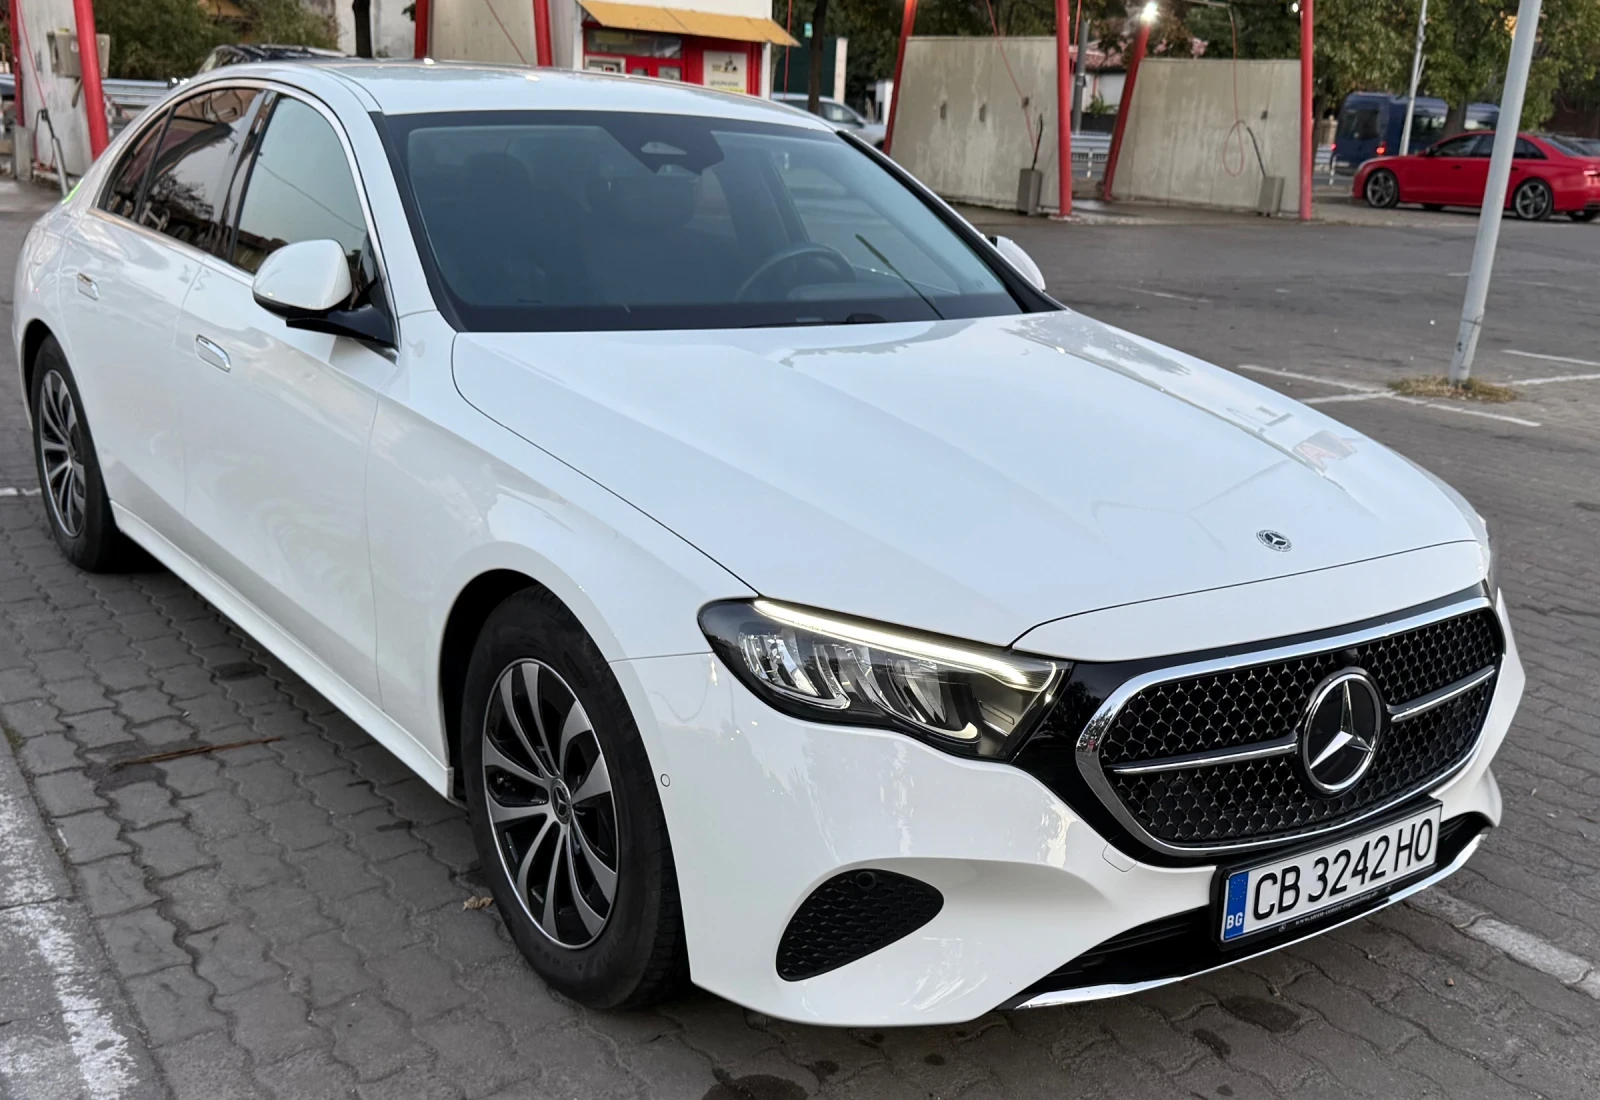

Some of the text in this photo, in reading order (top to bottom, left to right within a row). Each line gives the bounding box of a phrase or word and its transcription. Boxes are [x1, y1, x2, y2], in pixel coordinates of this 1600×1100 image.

[1253, 865, 1301, 921] CB
[1307, 835, 1390, 902] 3242
[1393, 818, 1433, 873] HO
[1226, 911, 1244, 930] BG
